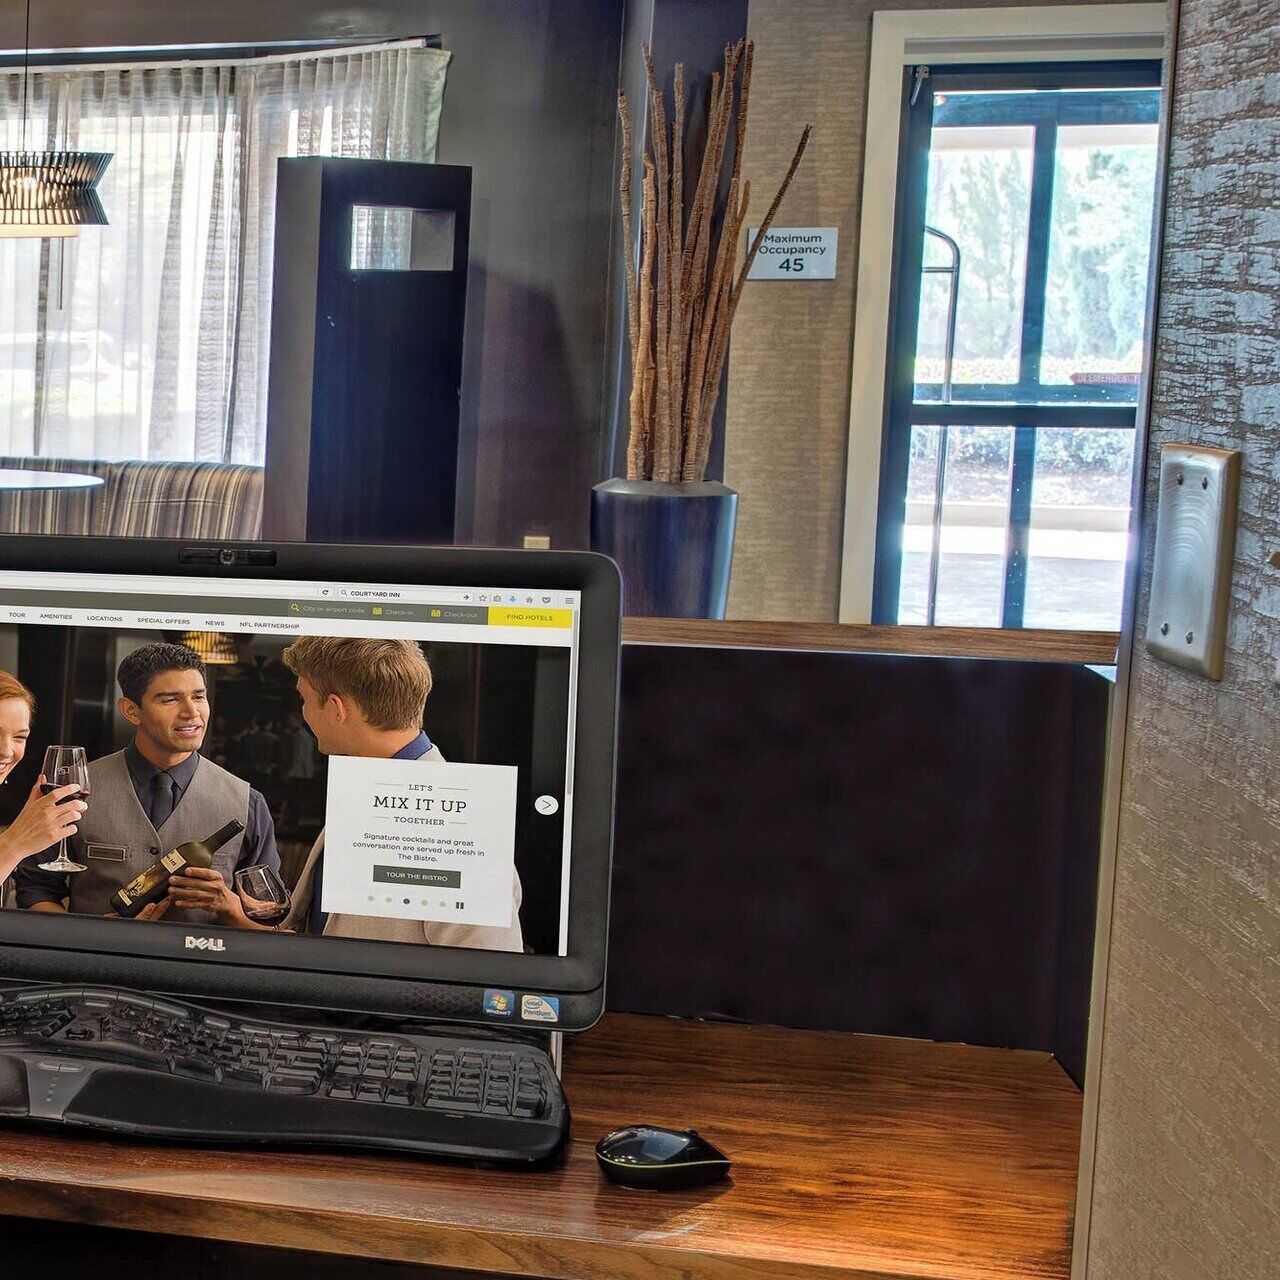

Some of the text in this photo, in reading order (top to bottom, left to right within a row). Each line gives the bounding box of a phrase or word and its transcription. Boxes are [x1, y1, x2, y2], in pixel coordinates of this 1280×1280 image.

[764, 234, 822, 243] Maximum
[759, 245, 827, 255] Occupancy
[779, 258, 804, 272] 45
[350, 590, 388, 598] COURTYARD
[137, 617, 191, 626] SPECIAL OFFERS
[254, 622, 300, 630] PARTNERSHIP
[408, 783, 433, 792] LET'S
[373, 795, 467, 813] MIX IT UP
[393, 816, 445, 826] TOGETHER
[363, 832, 400, 842] Signature
[402, 835, 435, 844] cocktails
[453, 839, 474, 848] great
[353, 841, 401, 851] conversation
[416, 846, 442, 854] served
[444, 848, 455, 856] up
[456, 848, 476, 857] fresh
[398, 853, 438, 863] The Bistro.
[386, 871, 406, 879] TOUR
[422, 874, 448, 882] BISTRO
[185, 936, 227, 951] DELL
